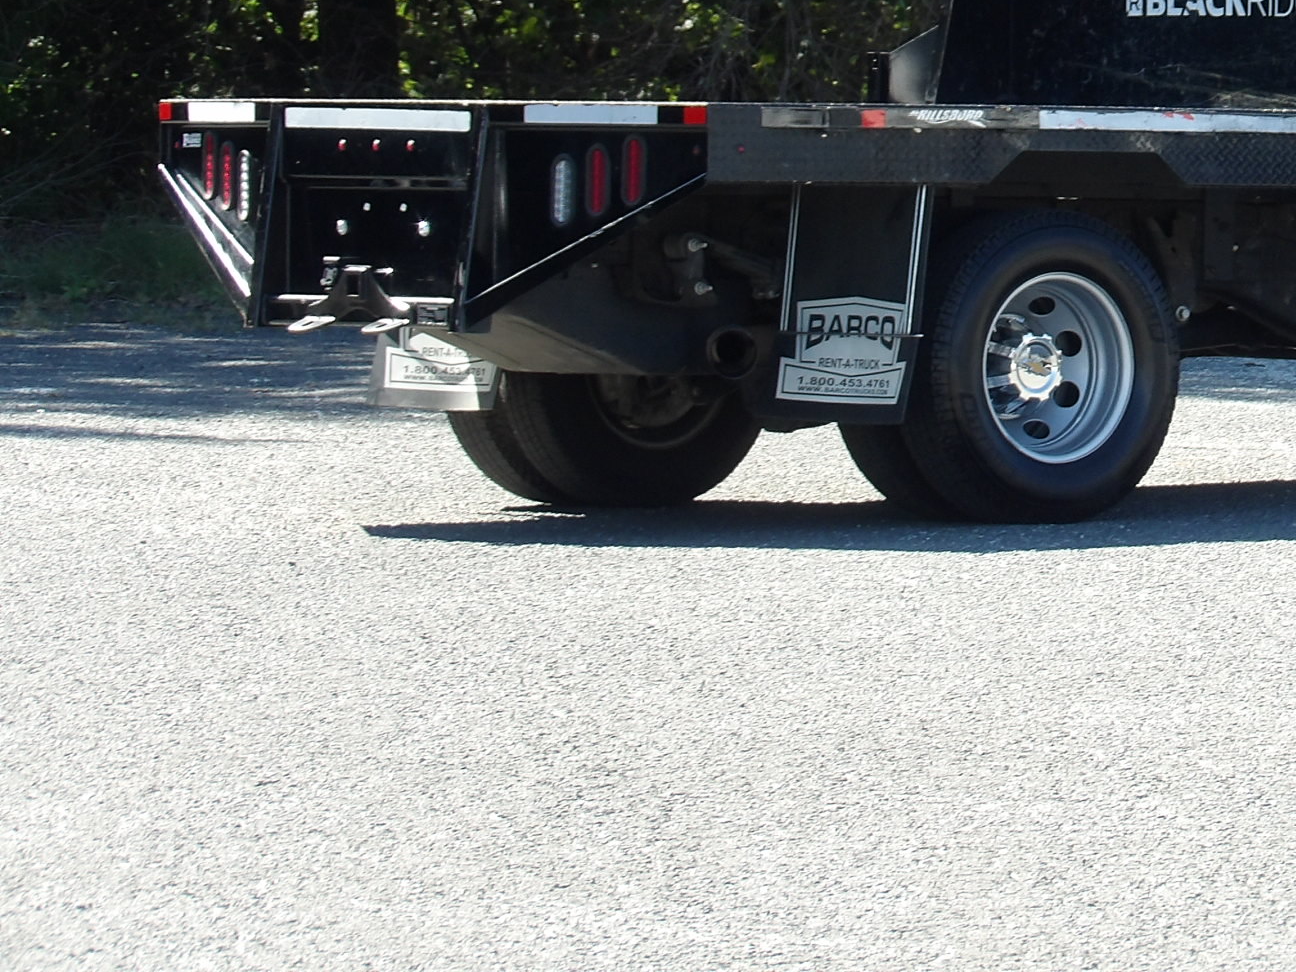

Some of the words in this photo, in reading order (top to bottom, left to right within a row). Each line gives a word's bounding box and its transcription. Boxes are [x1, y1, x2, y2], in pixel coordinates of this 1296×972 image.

[805, 312, 896, 350] BARCO
[818, 357, 880, 369] RENT-A-TRUCK
[797, 376, 890, 388] 1.800.453.4761
